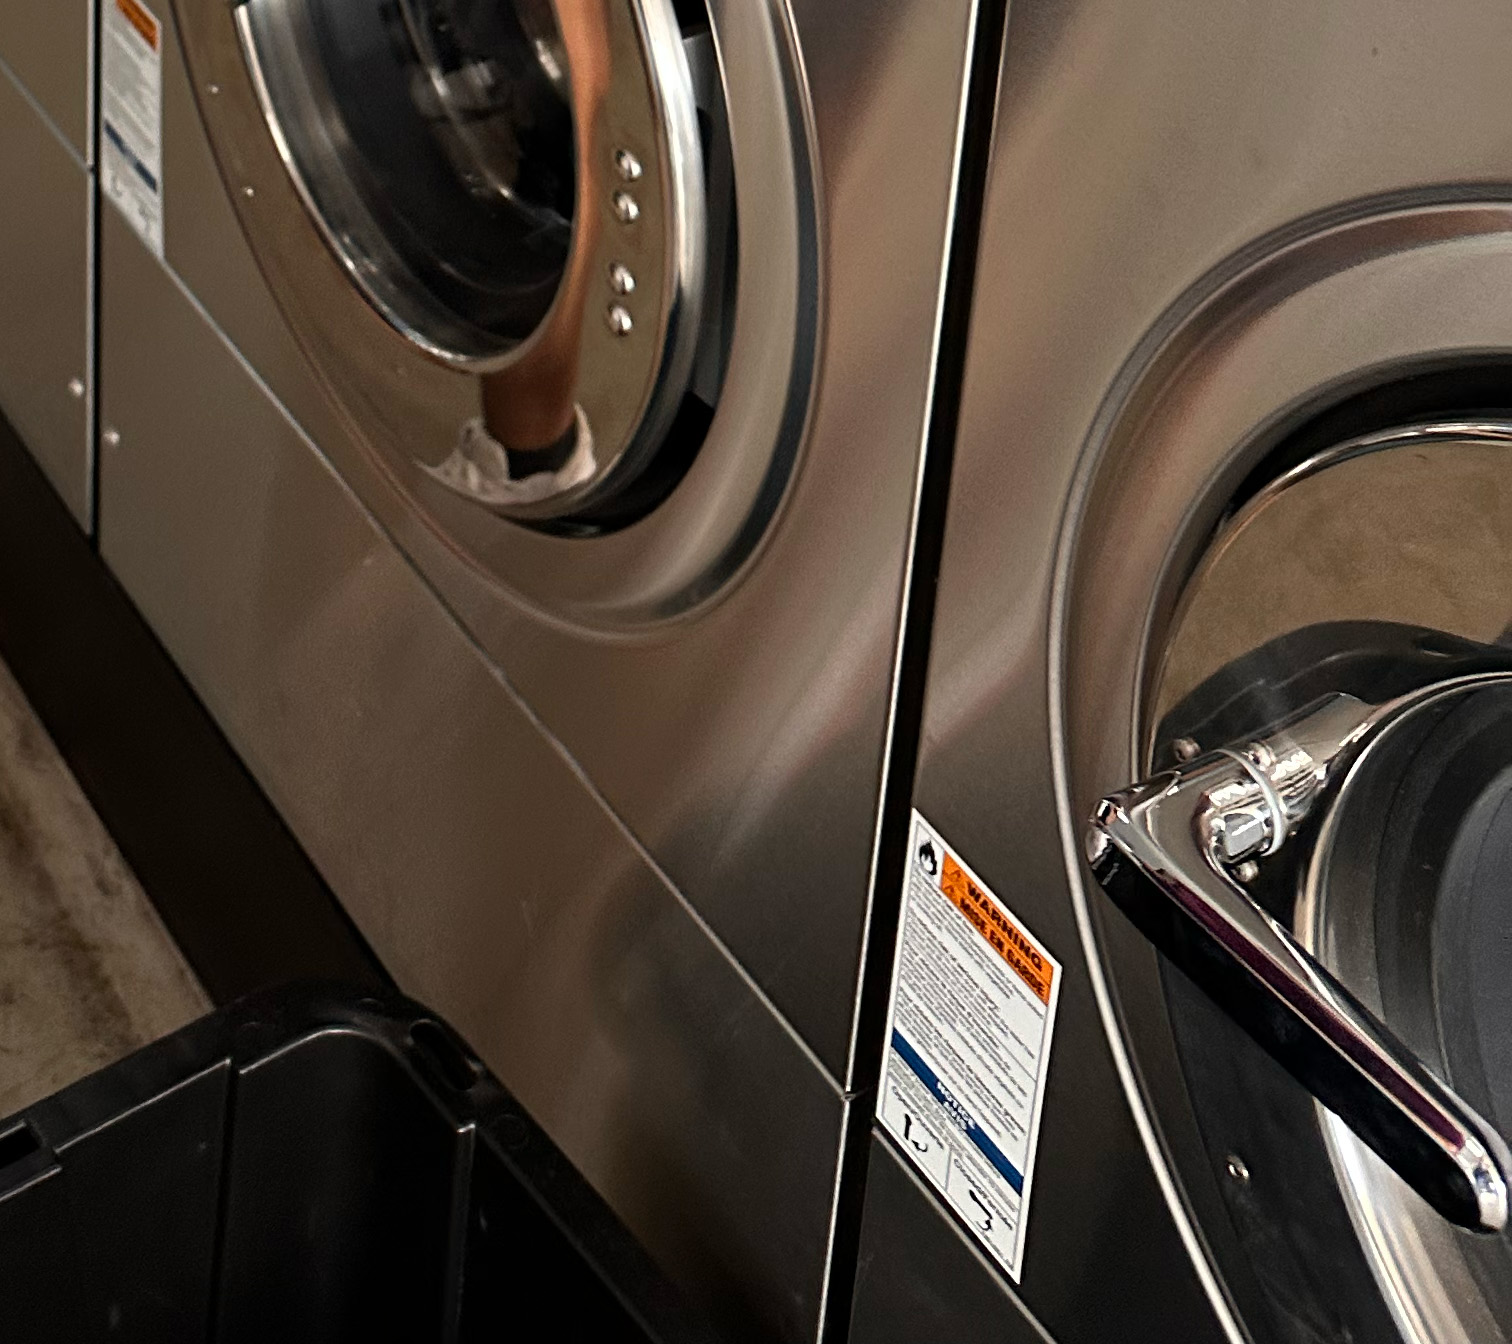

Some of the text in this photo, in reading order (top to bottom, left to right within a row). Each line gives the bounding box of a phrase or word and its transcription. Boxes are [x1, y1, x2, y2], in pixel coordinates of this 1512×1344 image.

[959, 896, 988, 936] MISE
[989, 928, 1005, 953] EN
[966, 881, 1043, 972] WARNING
